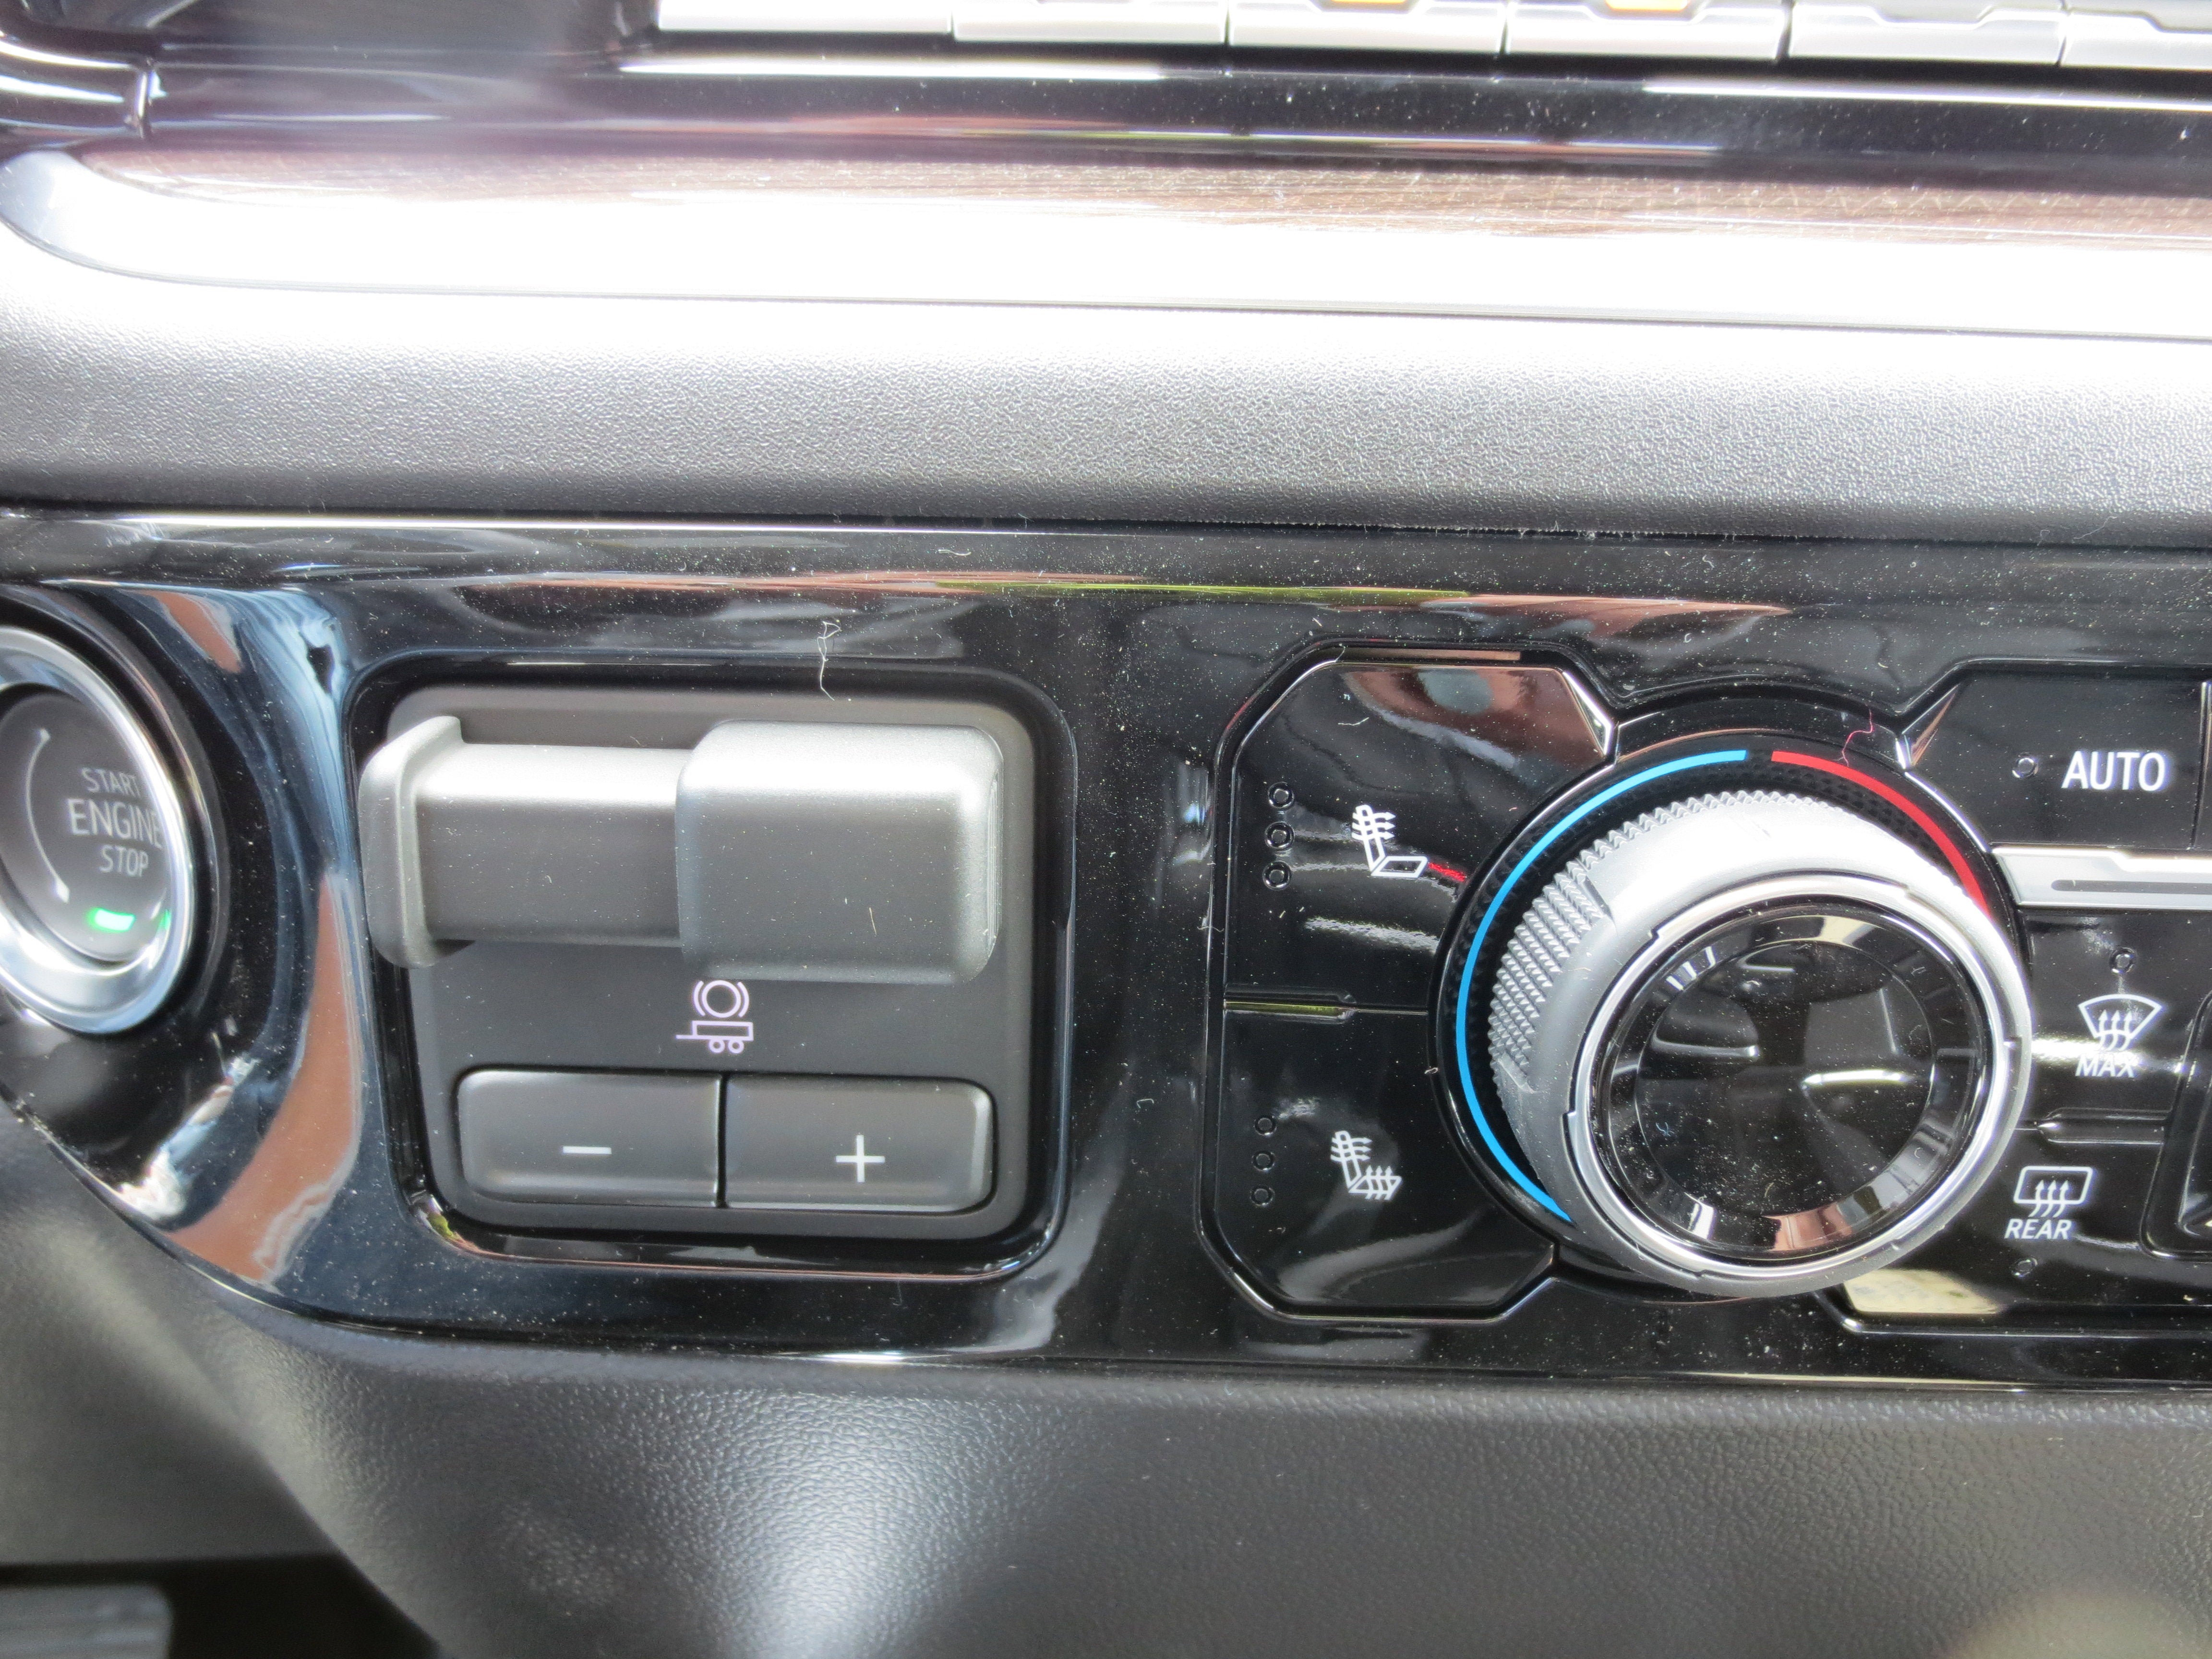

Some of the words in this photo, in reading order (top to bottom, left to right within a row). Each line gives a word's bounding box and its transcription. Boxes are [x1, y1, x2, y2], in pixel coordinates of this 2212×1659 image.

[81, 768, 141, 796] START
[2061, 750, 2169, 792] AUTO
[67, 798, 164, 849] ENGINE
[99, 845, 149, 878] STOP
[2075, 1055, 2135, 1077] MAX
[2004, 1218, 2073, 1240] REAR
